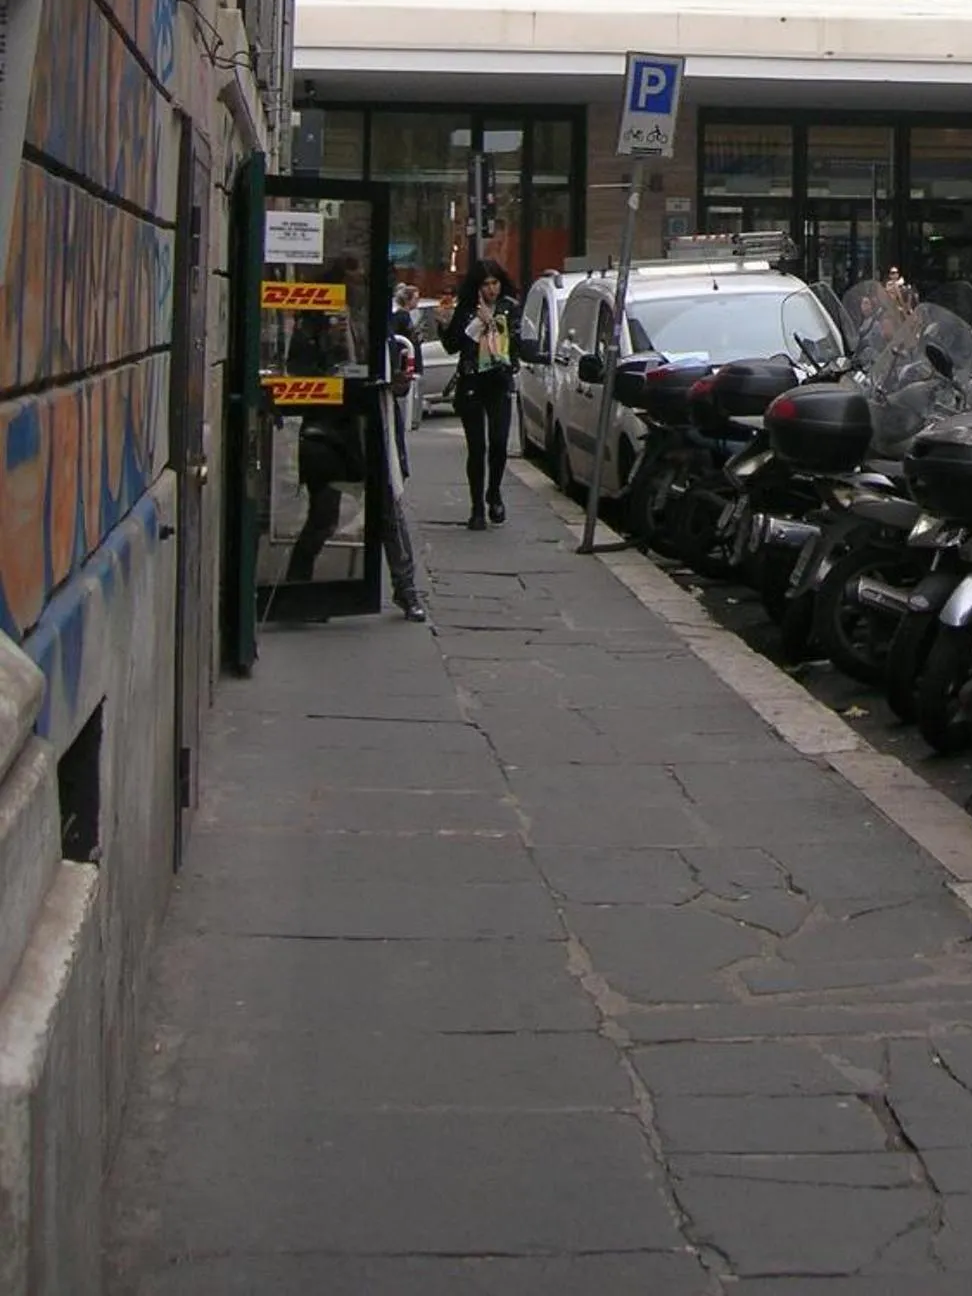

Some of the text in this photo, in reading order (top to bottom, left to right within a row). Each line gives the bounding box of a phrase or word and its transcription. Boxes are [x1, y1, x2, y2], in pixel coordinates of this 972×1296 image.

[638, 67, 666, 108] P
[263, 286, 333, 304] DHL
[274, 382, 330, 400] DHL
